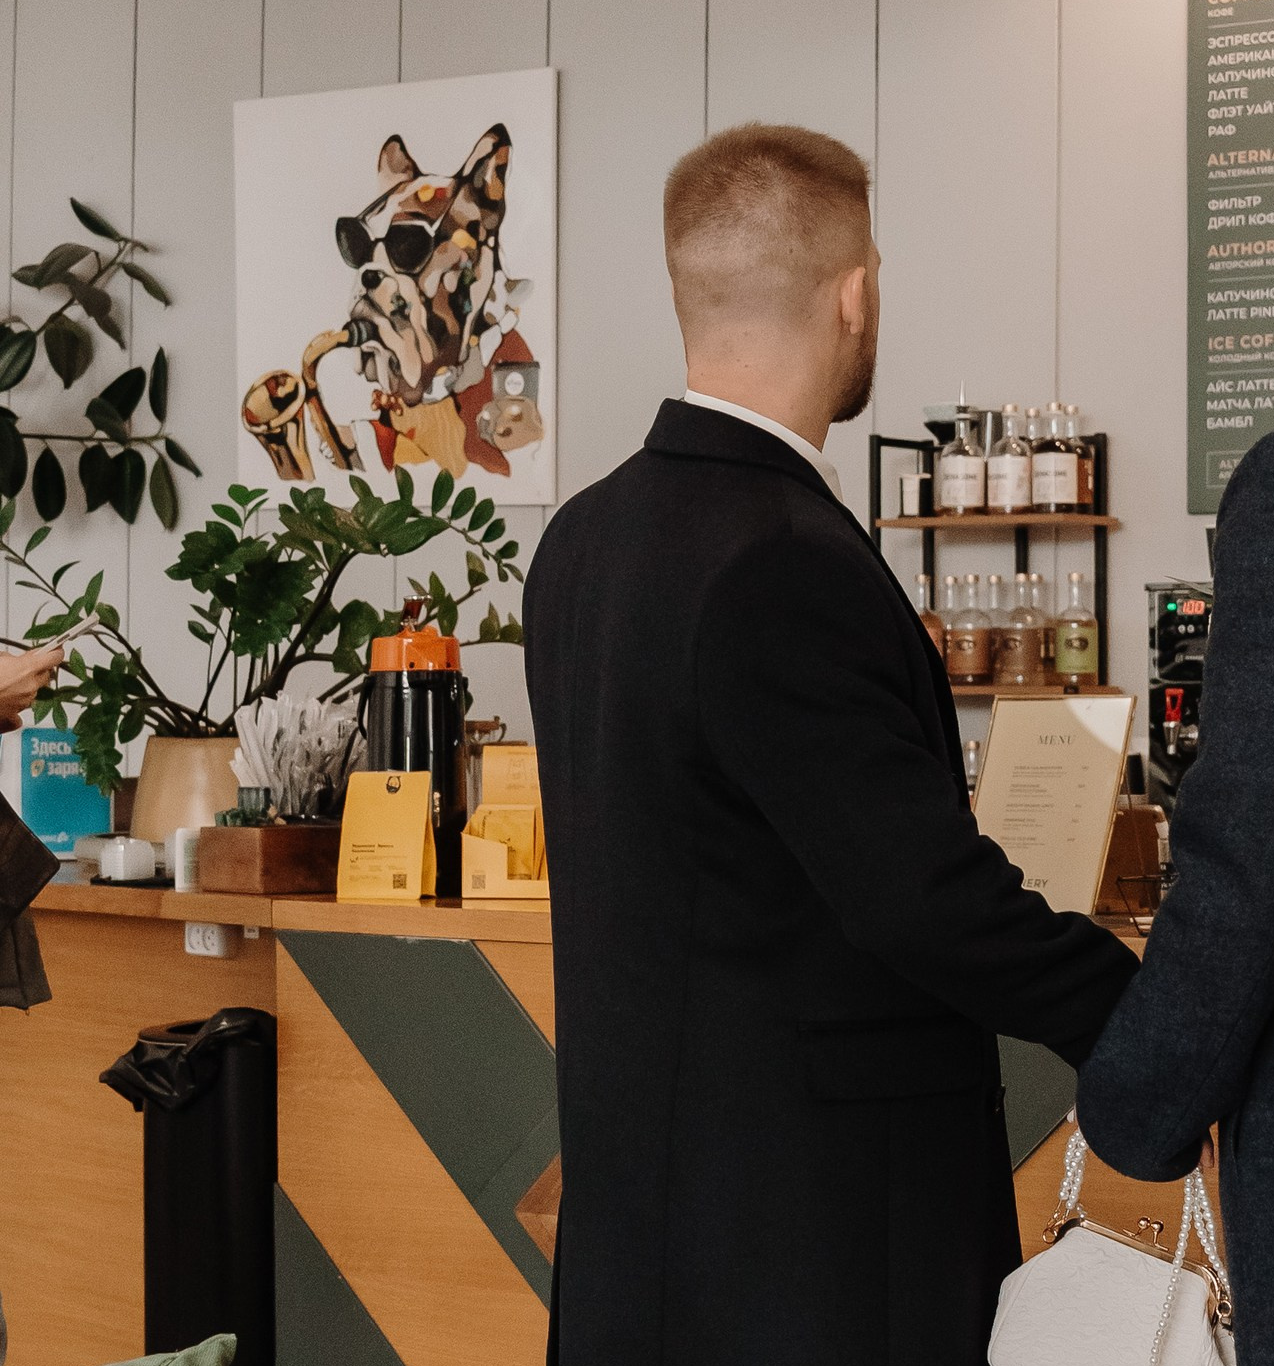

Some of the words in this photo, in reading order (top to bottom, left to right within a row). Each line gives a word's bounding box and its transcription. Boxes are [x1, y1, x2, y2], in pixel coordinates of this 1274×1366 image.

[1207, 6, 1234, 17] КОФЕ
[1207, 87, 1249, 103] ЛАТТЕ
[1207, 105, 1244, 119] ФЛЭТ
[1207, 123, 1237, 138] РАФ
[1207, 195, 1262, 211] ФИЛЬТР
[1207, 214, 1245, 230] ДРИП
[1208, 258, 1265, 271] АВТОРСКИЙ
[1207, 307, 1248, 322] ЛАТТЕ
[1208, 336, 1234, 350] ICE
[1206, 378, 1234, 393] АЙС
[1206, 398, 1250, 411] МАТЧА
[1206, 415, 1253, 429] БАМБЛ
[31, 737, 72, 756] Здесь
[1038, 734, 1076, 745] MENU
